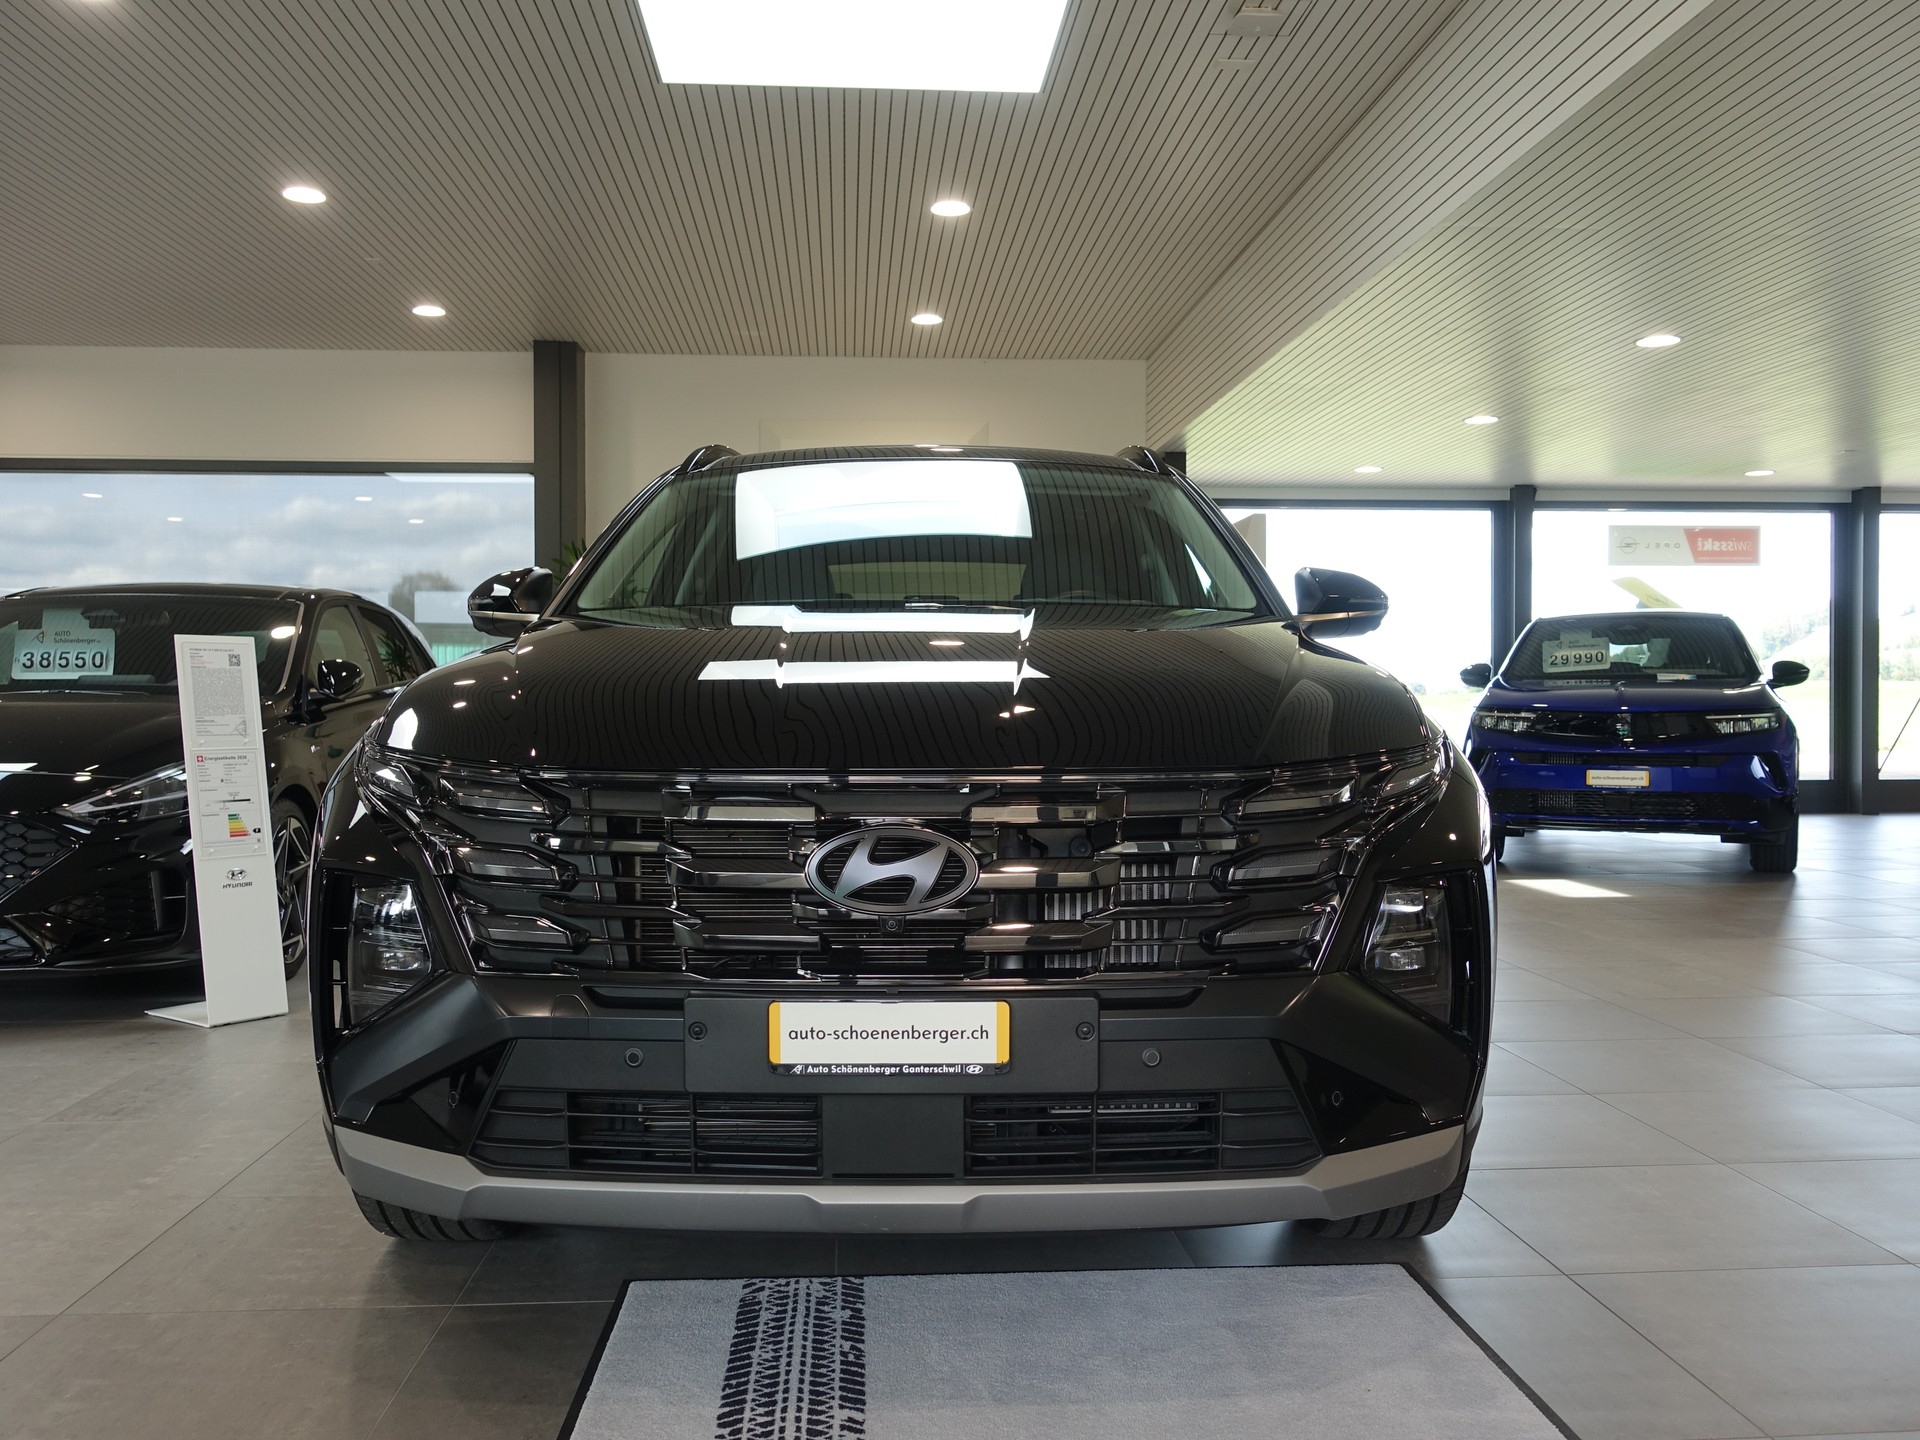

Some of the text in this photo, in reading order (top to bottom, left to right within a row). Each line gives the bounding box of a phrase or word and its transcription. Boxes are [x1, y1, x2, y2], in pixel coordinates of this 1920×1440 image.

[22, 651, 104, 669] 38550
[1550, 651, 1604, 666] 29990
[222, 881, 253, 889] HYUNDAI
[788, 1025, 989, 1043] auto-schoenenberger.ch
[807, 1064, 961, 1075] Auto Schönenberger Ganterschwil
